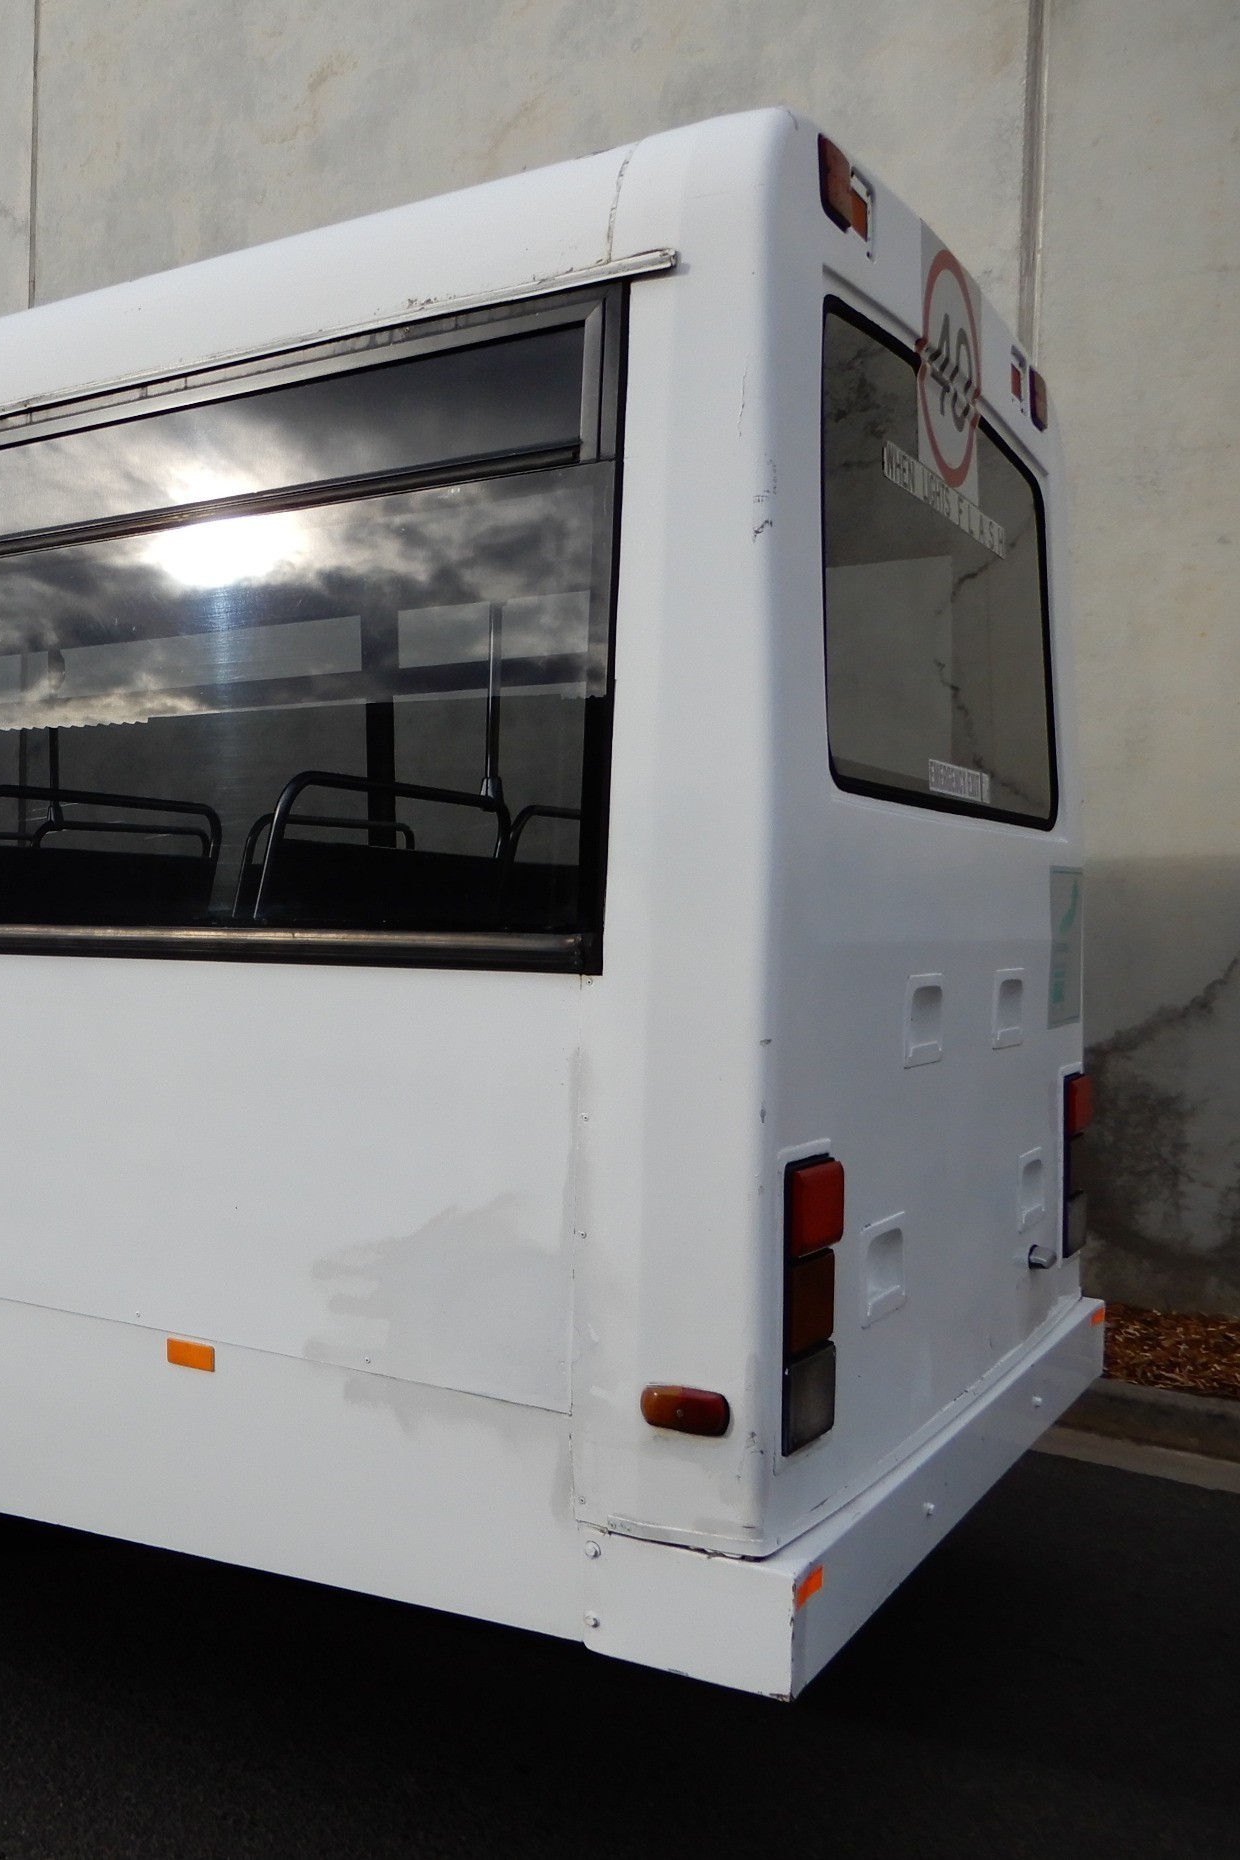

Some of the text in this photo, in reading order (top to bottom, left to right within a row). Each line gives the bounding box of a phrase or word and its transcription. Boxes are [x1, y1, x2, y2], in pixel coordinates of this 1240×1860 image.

[926, 313, 972, 432] 40
[884, 443, 1006, 557] WHEN LIGHTS FLASH
